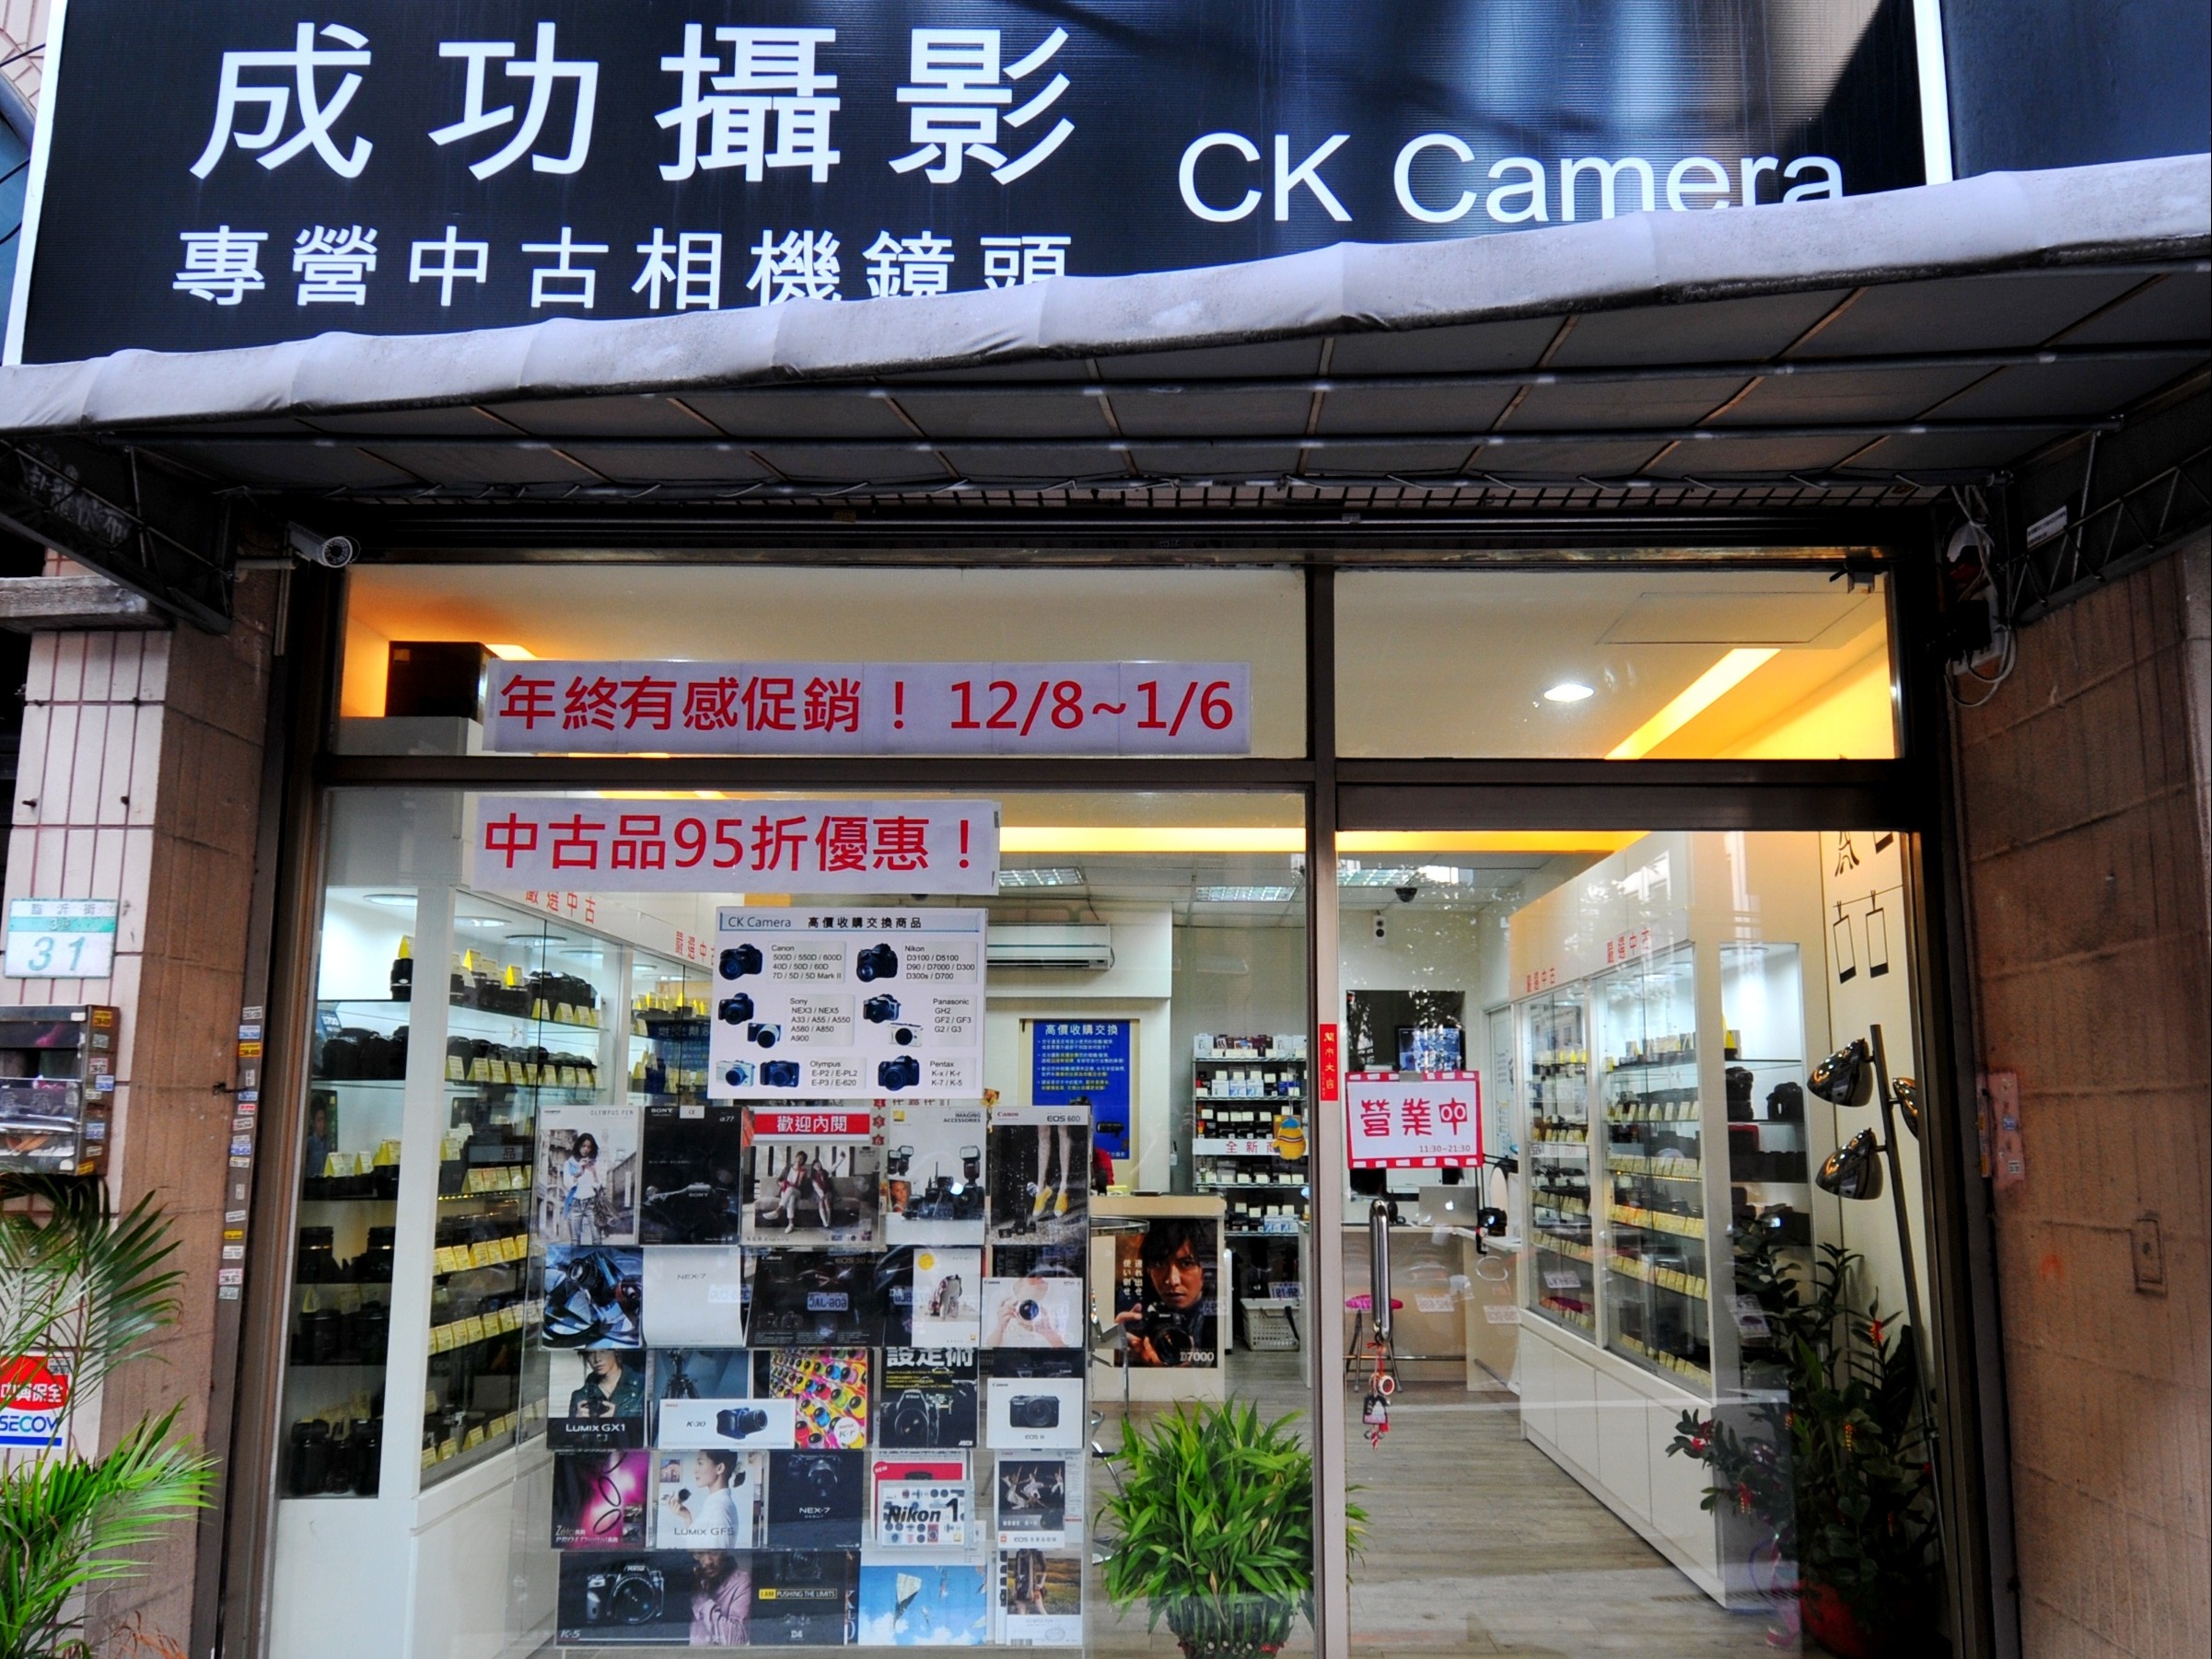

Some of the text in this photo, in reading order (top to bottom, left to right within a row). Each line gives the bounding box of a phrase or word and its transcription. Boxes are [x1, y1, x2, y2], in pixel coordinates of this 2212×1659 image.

[190, 22, 1076, 184] 成功攝影
[1179, 133, 1843, 223] CK Camera
[173, 225, 1072, 309] 專營中古相機鏡頭
[498, 675, 1234, 737] 年終有感促銷！ 12/8~1/6
[483, 810, 972, 872] 中古品95折優惠！
[728, 917, 791, 928] CK Camera
[808, 917, 921, 929] 高價收購交換商品
[28, 936, 86, 971] 31
[789, 997, 808, 1006] Sony
[819, 1006, 839, 1015] NEX5
[1045, 1024, 1119, 1036] 高價收購交換
[809, 1060, 841, 1069] Olympus
[1360, 1097, 1468, 1137] 營業中
[777, 1115, 847, 1132] 歡迎內閱
[1180, 1352, 1215, 1362] D7000
[601, 1423, 626, 1432] GX1
[887, 1498, 958, 1523] Nikon 1
[674, 1527, 706, 1536] LUMIX
[560, 1630, 581, 1638] K-5
